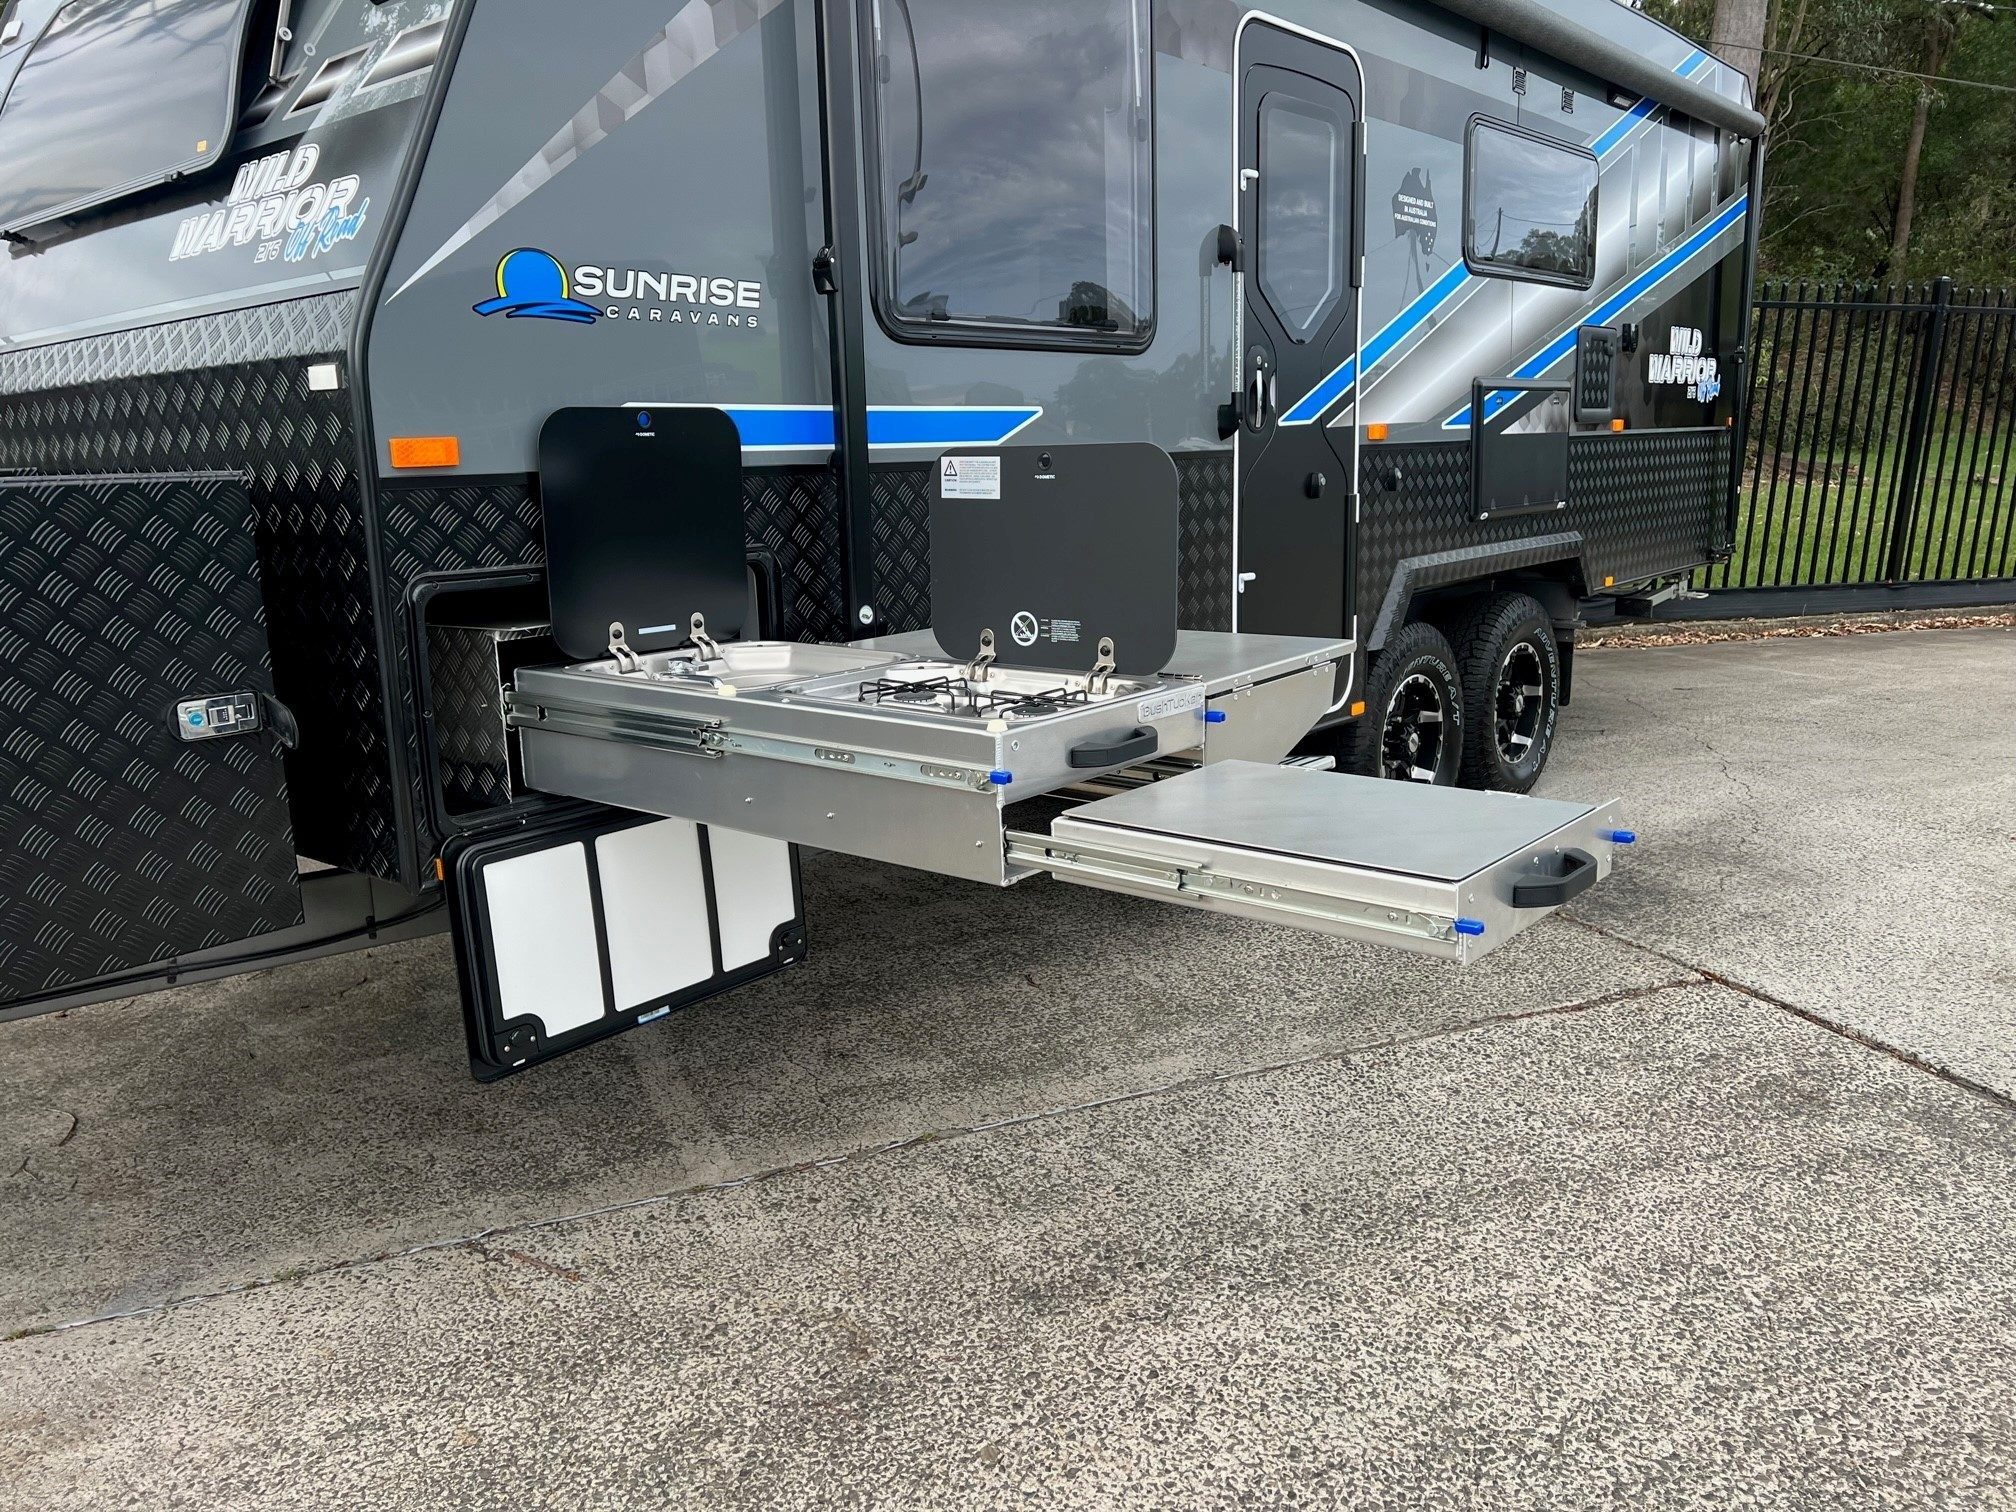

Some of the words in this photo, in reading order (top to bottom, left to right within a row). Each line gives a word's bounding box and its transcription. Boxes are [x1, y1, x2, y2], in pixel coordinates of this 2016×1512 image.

[227, 144, 320, 206] WILD
[169, 174, 360, 262] WARRIOR
[311, 197, 370, 260] Road
[573, 264, 762, 309] SUNRISE
[606, 305, 759, 329] CARAVANS
[1669, 326, 1703, 357] WILD
[1648, 353, 1717, 385] WARRIOR
[1448, 685, 1460, 725] A/T
[1534, 627, 1558, 738] ADVENTURE
